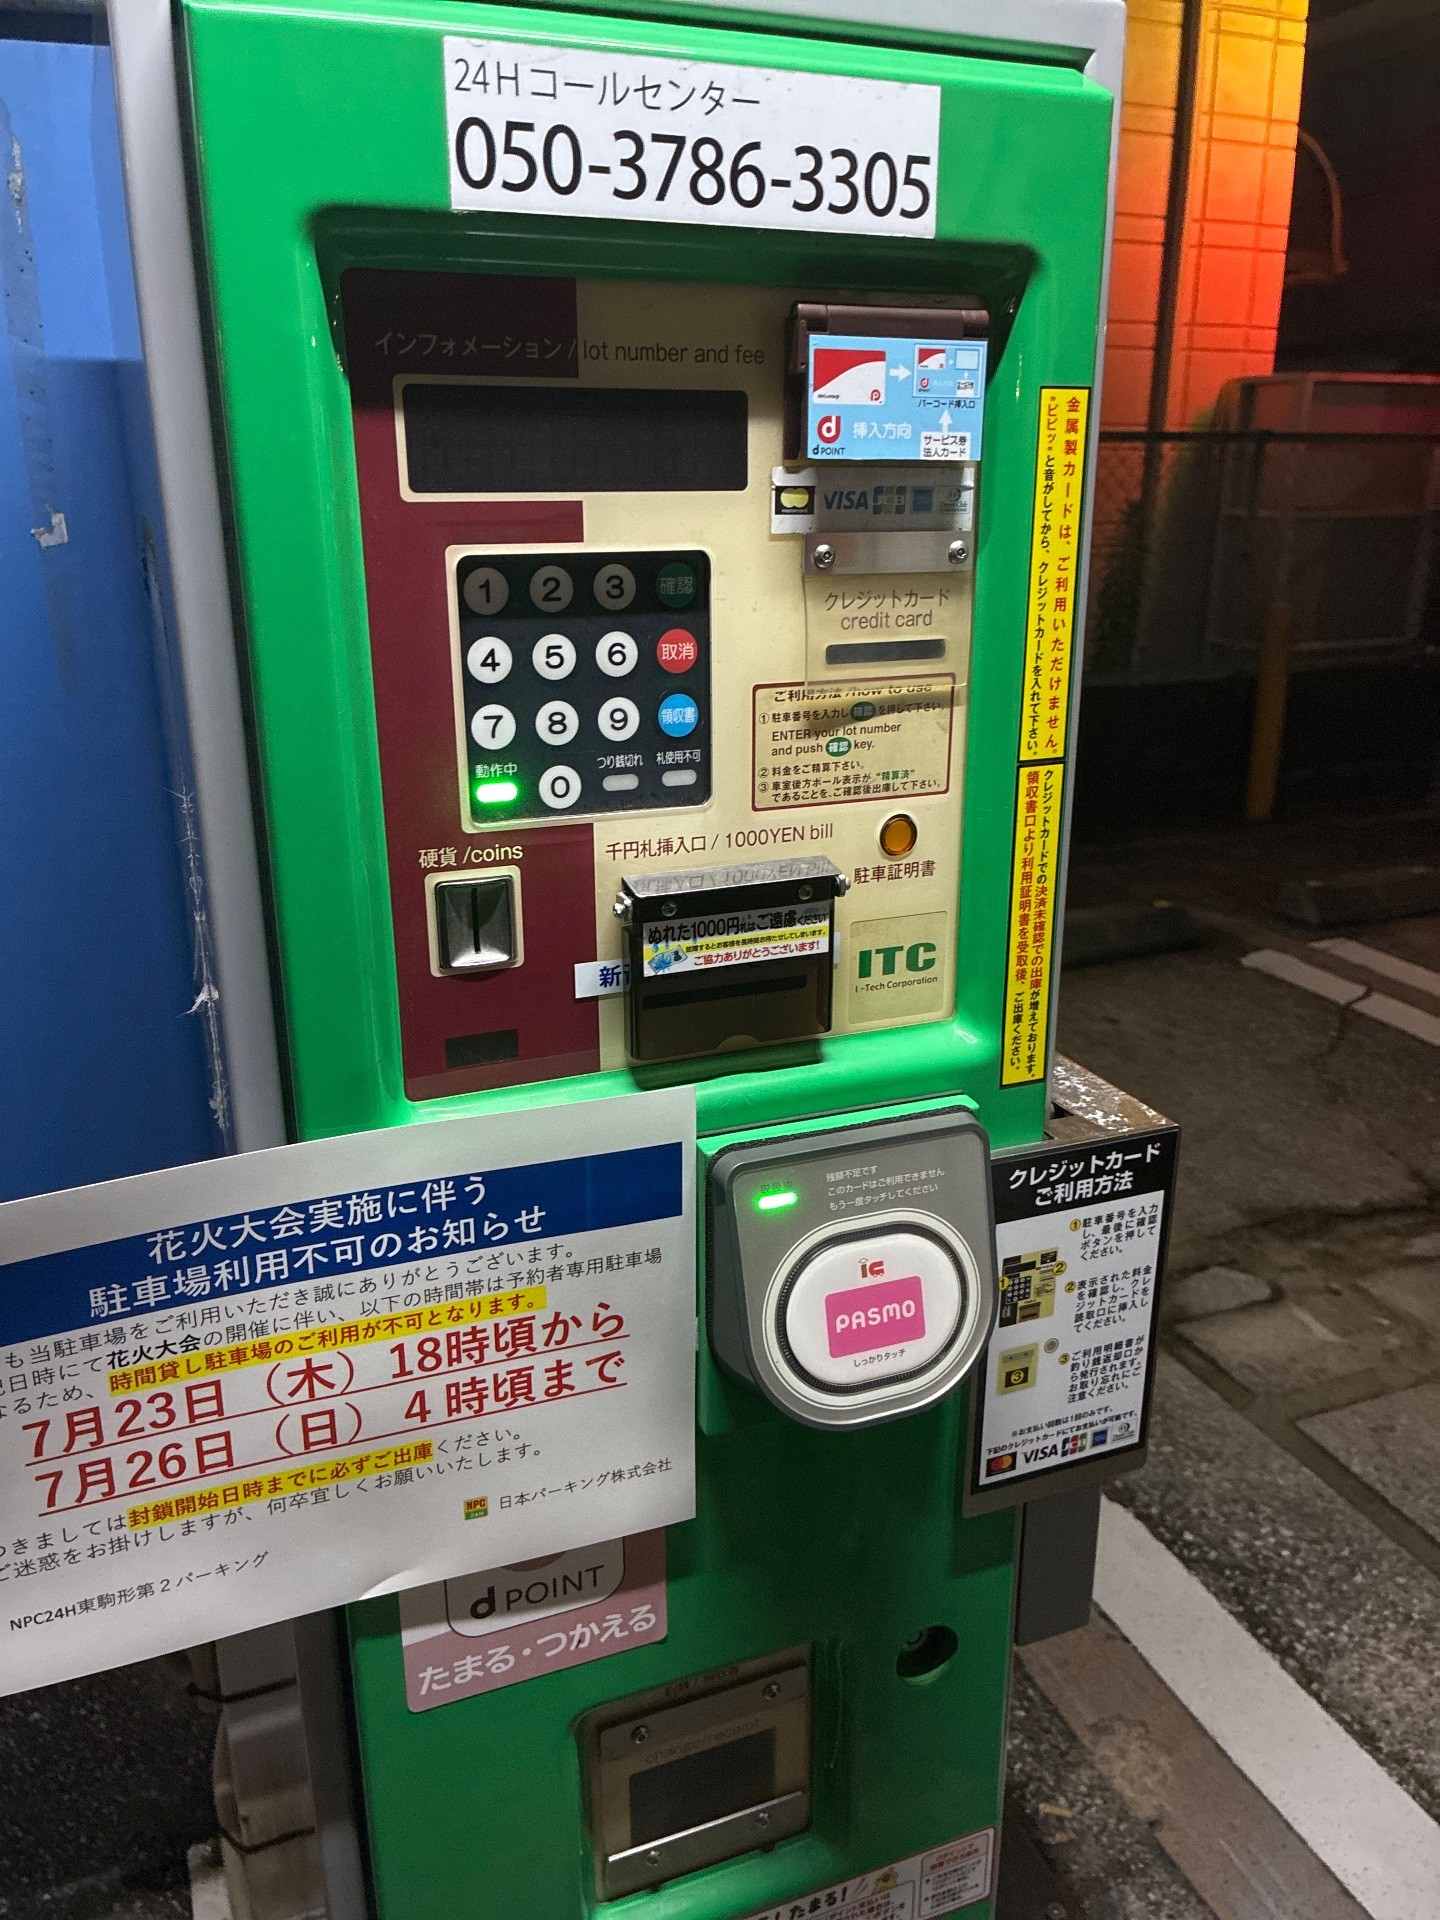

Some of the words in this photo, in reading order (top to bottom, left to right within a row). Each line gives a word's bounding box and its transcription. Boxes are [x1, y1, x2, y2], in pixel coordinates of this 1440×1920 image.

[455, 116, 931, 220] 050-3786-3305
[375, 331, 562, 360] インフォメーション
[584, 340, 608, 361] lot
[615, 341, 688, 364] number
[694, 343, 729, 364] and
[734, 345, 764, 365] fee
[918, 400, 976, 409] バーコード挿入口
[852, 421, 912, 440] 挿入方向
[923, 435, 967, 446] サービス券
[821, 447, 846, 455] POINT
[923, 447, 967, 458] 法人カード
[824, 491, 868, 510] VISA
[660, 576, 695, 596] 確認
[1044, 396, 1081, 754] 金属製カードは、ご利用いただけません。
[480, 580, 491, 603] 1
[542, 577, 562, 602] 2
[606, 575, 625, 599] 3
[824, 588, 950, 612] クレジットカード
[841, 611, 891, 631] credit
[896, 609, 932, 628] card
[480, 648, 500, 672] 4
[545, 645, 565, 669] 5
[607, 643, 627, 666] 6
[660, 642, 695, 660] 取消
[483, 715, 503, 739] 7
[548, 712, 567, 734] 8
[610, 708, 628, 730] 9
[661, 707, 696, 725] 領収書
[772, 707, 849, 724] 駐車番号を入力し
[772, 729, 811, 742] ENTER
[815, 728, 840, 740] your
[843, 726, 857, 736] lot
[860, 723, 902, 734] number
[656, 749, 702, 765] 札使用不可
[772, 745, 792, 756] and
[796, 743, 823, 757] push
[854, 740, 875, 751] key.
[475, 762, 518, 779] 動作中
[596, 753, 643, 769] つり銭切れ
[772, 760, 865, 777] 料金をご精算下さい。
[551, 776, 570, 798] 0
[605, 835, 706, 862] 千円札挿入口
[725, 826, 805, 848] 1000YEN
[810, 823, 834, 840] bill
[418, 846, 457, 869] 硬貨
[854, 860, 936, 884] 駐車証明書
[858, 942, 937, 979] ITC
[887, 976, 938, 991] Corporation
[1008, 1142, 1160, 1190] クレジットカード
[827, 1168, 945, 1196] このカードはご利用できません
[1035, 1171, 1134, 1206] ご利用方法
[829, 1183, 939, 1211] もう一度タッチしてください
[147, 1175, 487, 1265] 花火大会実施に伴う
[1082, 1204, 1159, 1228] 駐車番号を入力
[1083, 1215, 1158, 1239] し、最後に確認
[1080, 1225, 1157, 1250] ボタンを押して
[89, 1205, 547, 1318] 駐車場利用不可のお知らせ
[1080, 1245, 1123, 1261] ください。
[1077, 1265, 1152, 1290] 表示された料金
[5, 1243, 574, 1369] も当駐車場をご利用いただき誠にありがとうございます。
[1076, 1287, 1149, 1311] ジットカードを
[1074, 1313, 1126, 1333] てください。
[853, 1348, 906, 1368] しっかりタッチ
[22, 1380, 226, 1458] 7月23日
[389, 1302, 626, 1379] 18時頃から
[1069, 1366, 1142, 1392] お取り忘れにご
[1067, 1382, 1129, 1403] 注意ください。
[1021, 1444, 1058, 1463] VISA
[35, 1430, 235, 1509] 7月26日
[499, 1458, 672, 1510] 日本パーキング株式会社
[505, 1564, 605, 1611] POINT
[418, 1603, 657, 1696] たまる・つかえる
